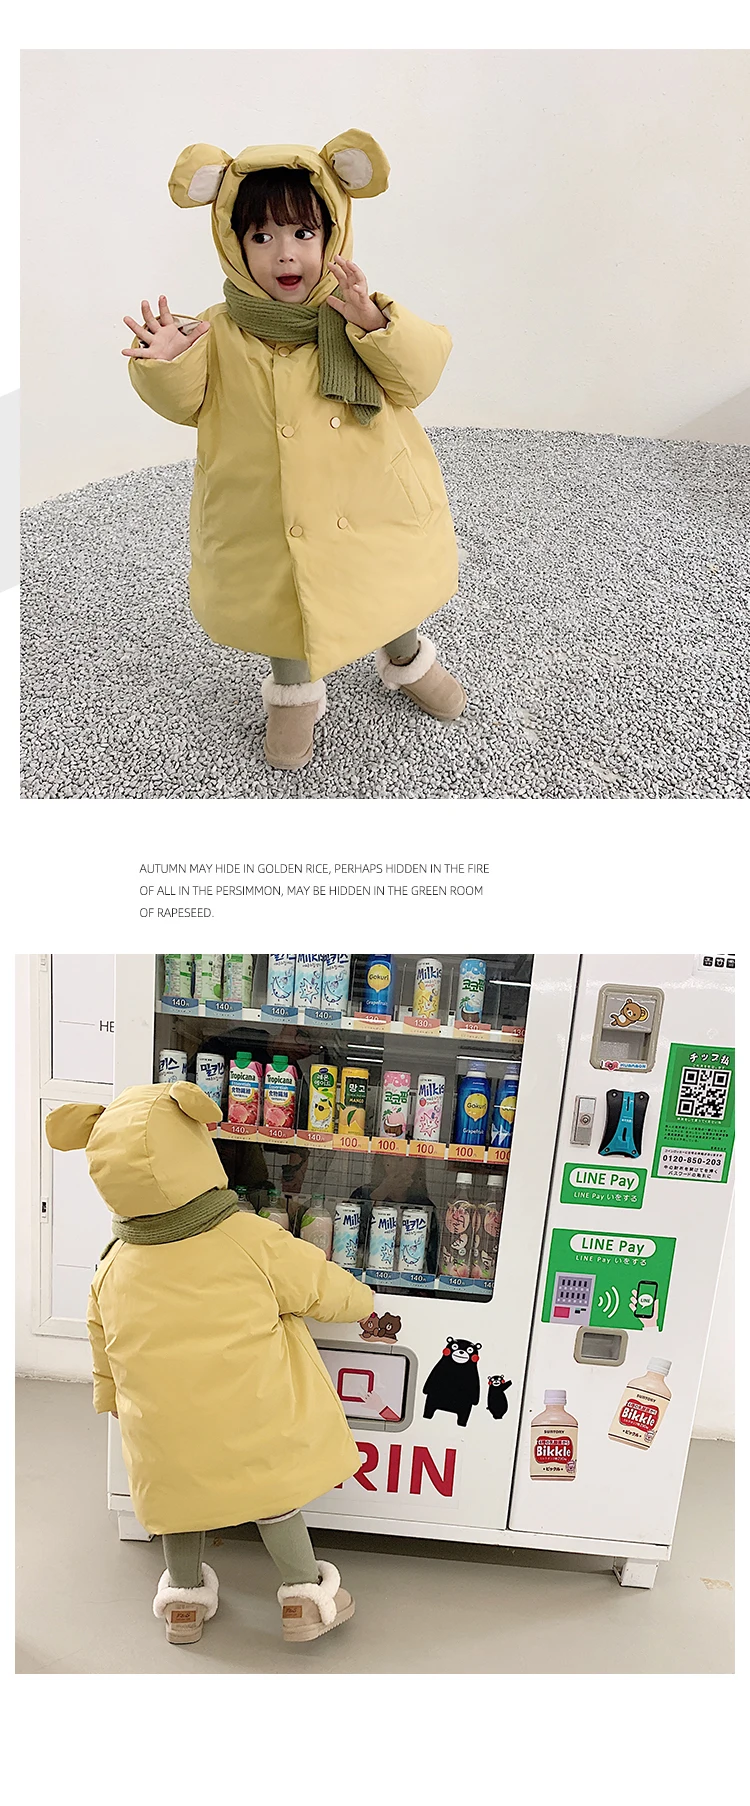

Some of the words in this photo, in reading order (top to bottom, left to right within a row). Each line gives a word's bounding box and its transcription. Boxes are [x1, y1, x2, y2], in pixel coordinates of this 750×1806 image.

[230, 1071, 256, 1081] Tropicana
[266, 1074, 293, 1085] Tropicana
[662, 1154, 722, 1167] 0120-850-203
[575, 1171, 607, 1186] LINE
[610, 1174, 635, 1190] Pay
[592, 1193, 605, 1201] Pay
[581, 1237, 614, 1251] LINE
[618, 1240, 645, 1256] Pay
[597, 1256, 611, 1265] Pay
[621, 1407, 656, 1427] Bikkle
[536, 1446, 571, 1457] Bikkle
[334, 1442, 457, 1497] RIN
